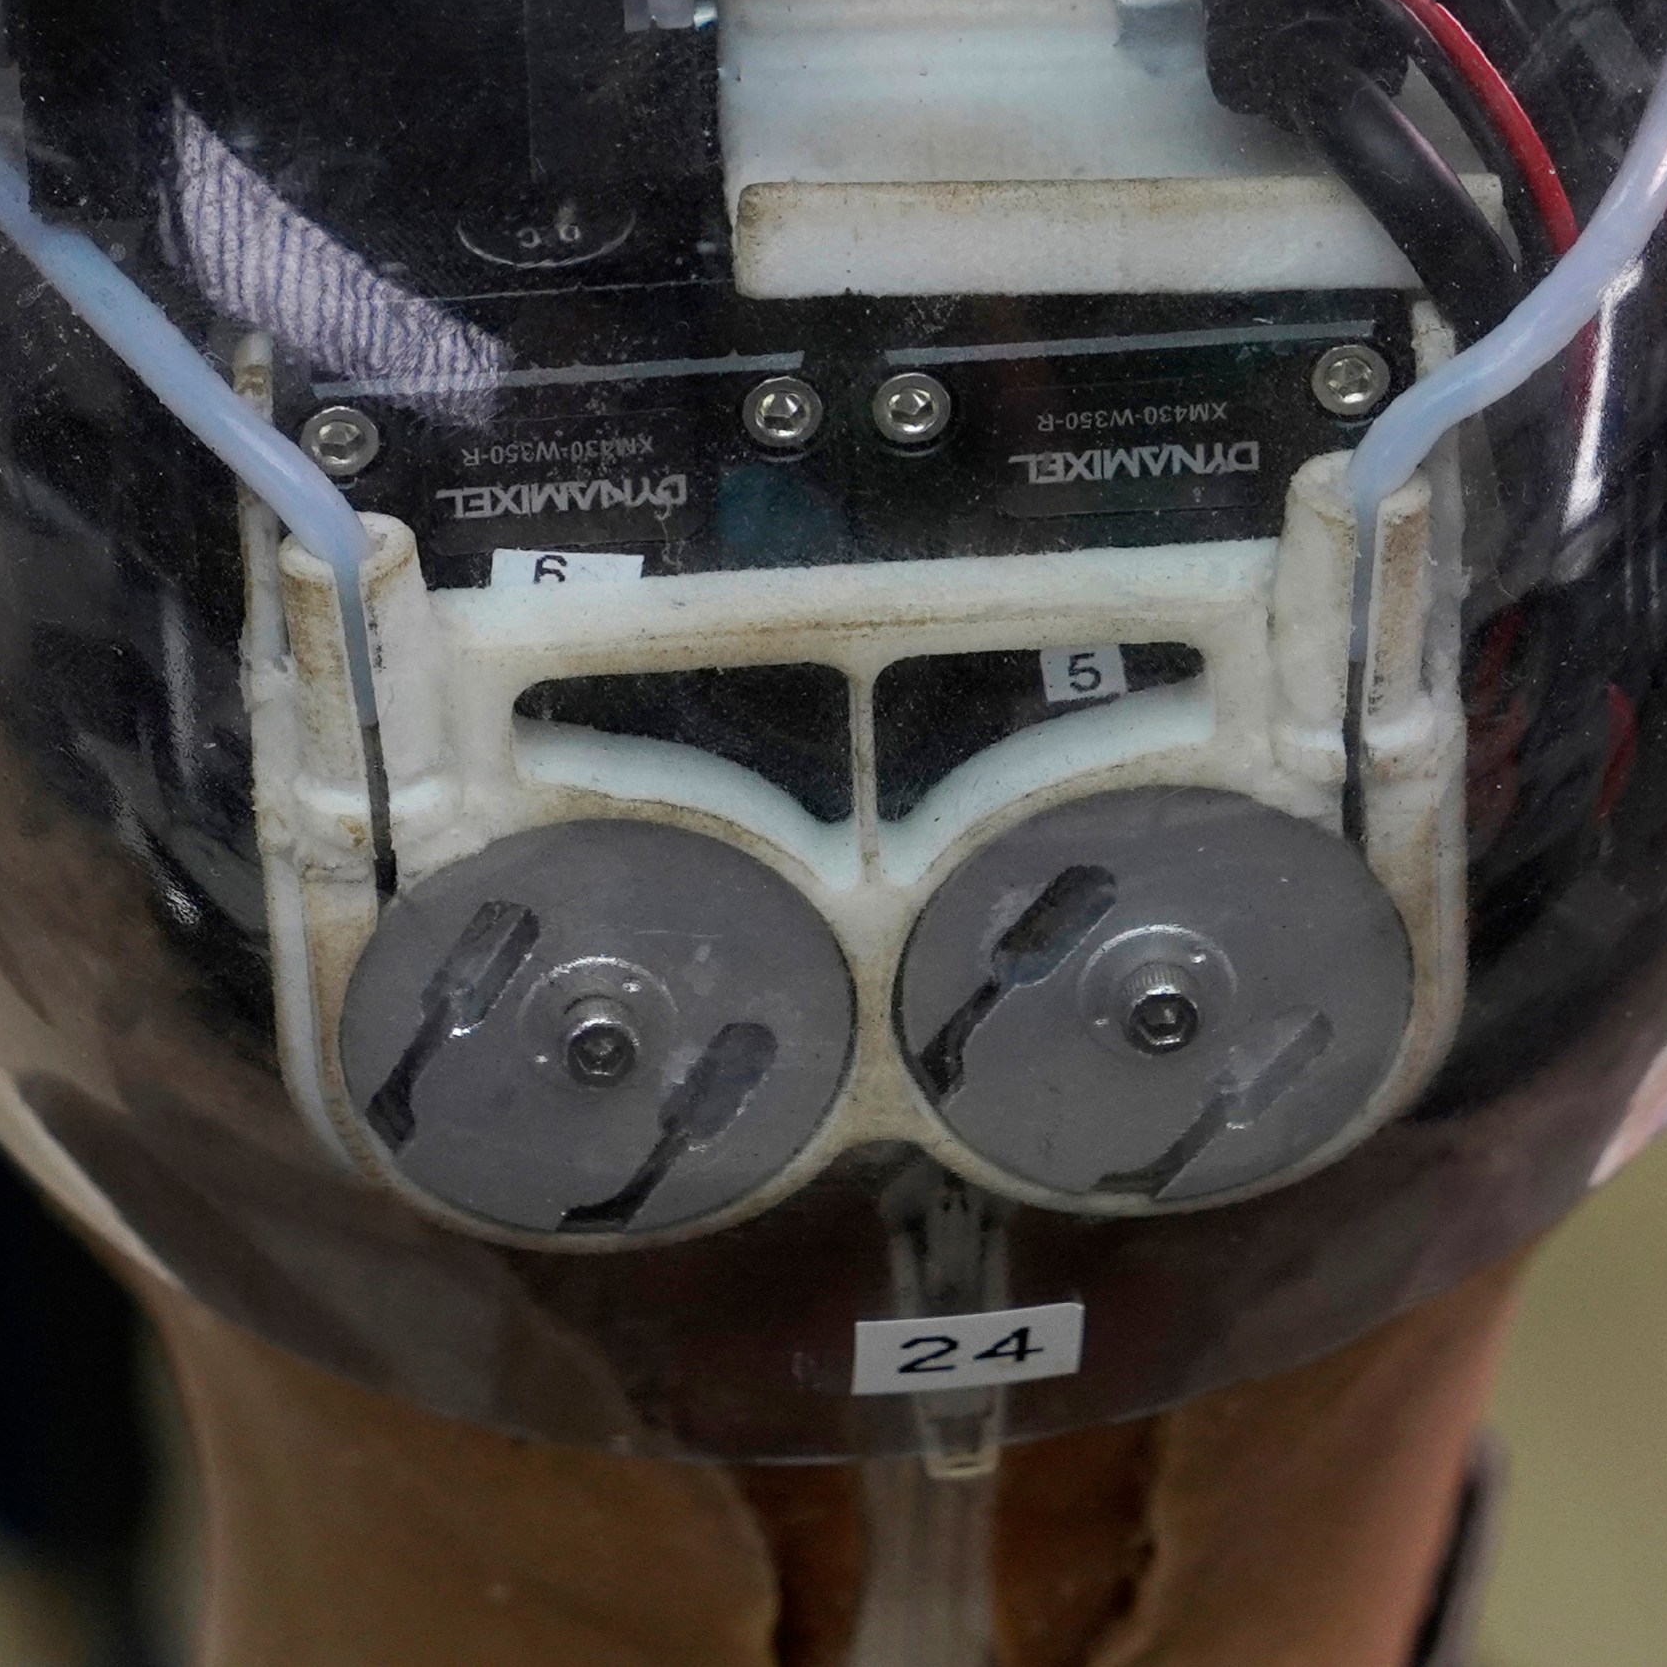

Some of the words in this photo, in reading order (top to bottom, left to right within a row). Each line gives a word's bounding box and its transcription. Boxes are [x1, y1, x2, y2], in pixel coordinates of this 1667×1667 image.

[1037, 401, 1229, 432] XM430-W350-R
[460, 435, 655, 468] XM430-W350-R
[1008, 440, 1260, 485] DYNAMIXEL
[435, 473, 687, 519] DYNAMIXEL
[1068, 652, 1102, 692] 5
[897, 1326, 1045, 1374] 24
